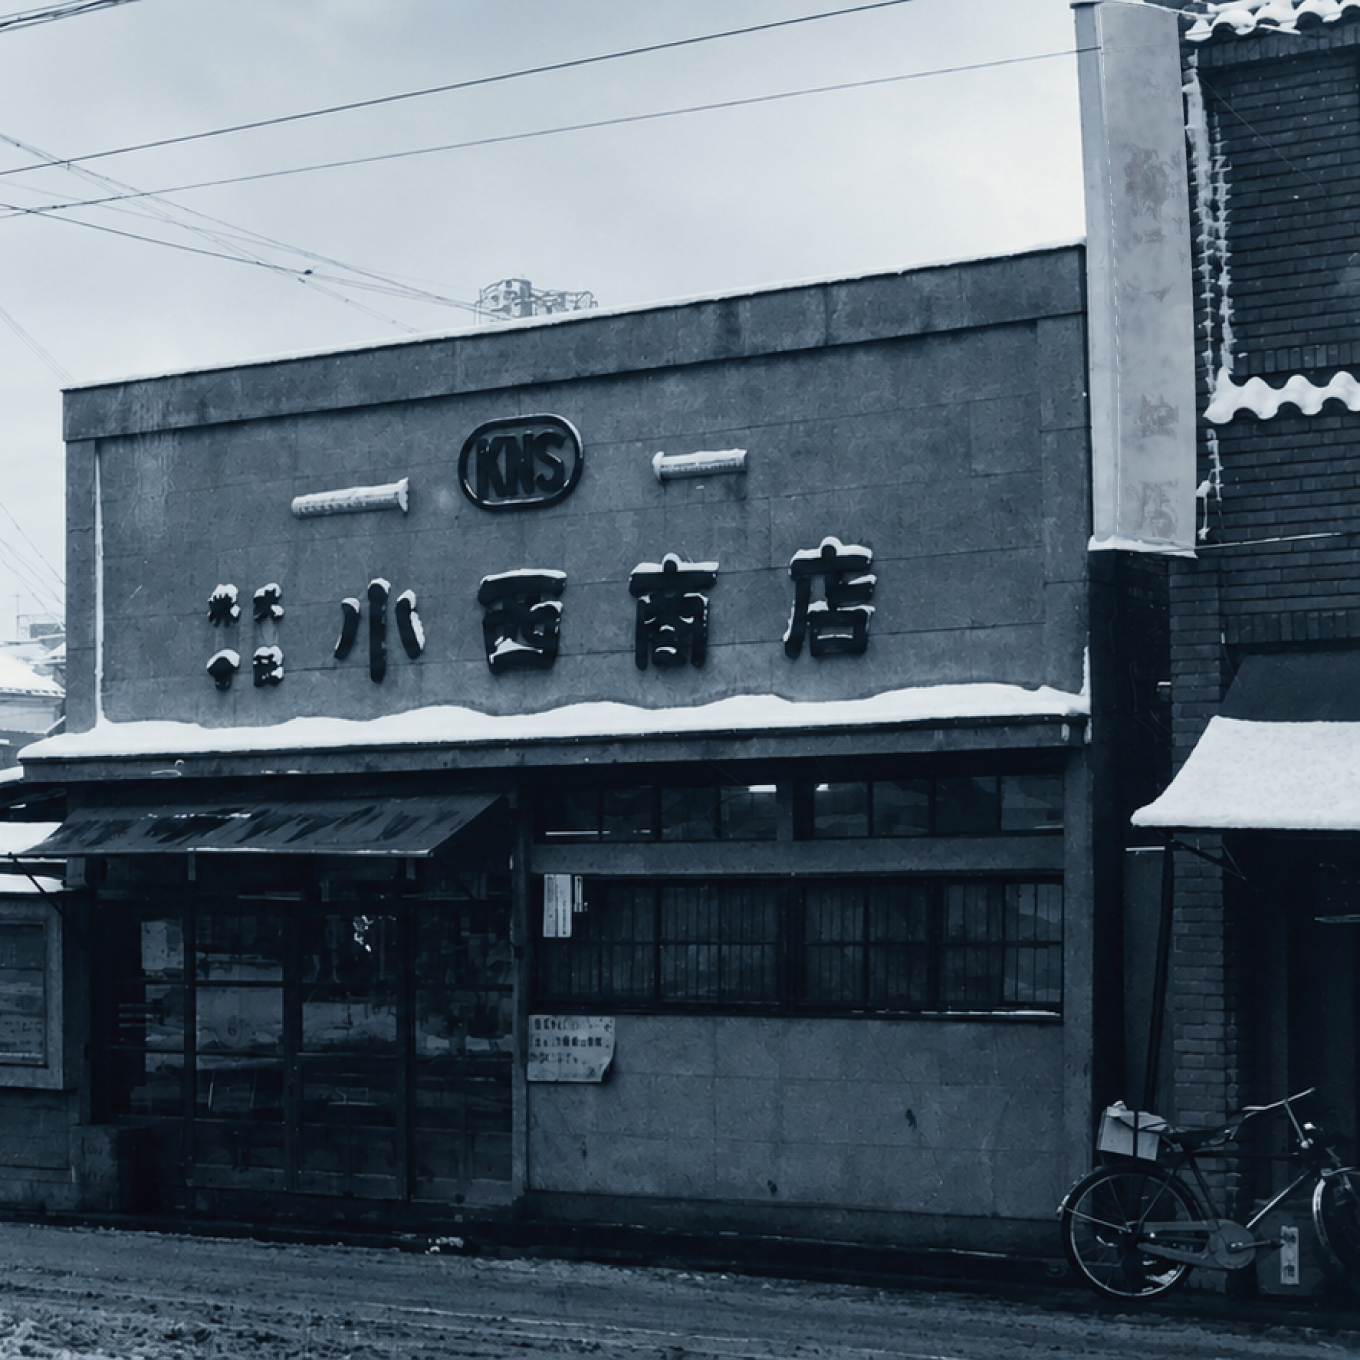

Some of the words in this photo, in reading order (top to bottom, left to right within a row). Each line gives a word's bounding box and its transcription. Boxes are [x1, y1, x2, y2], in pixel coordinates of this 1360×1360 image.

[476, 430, 566, 500] KNS
[333, 536, 877, 683] 小西商店
